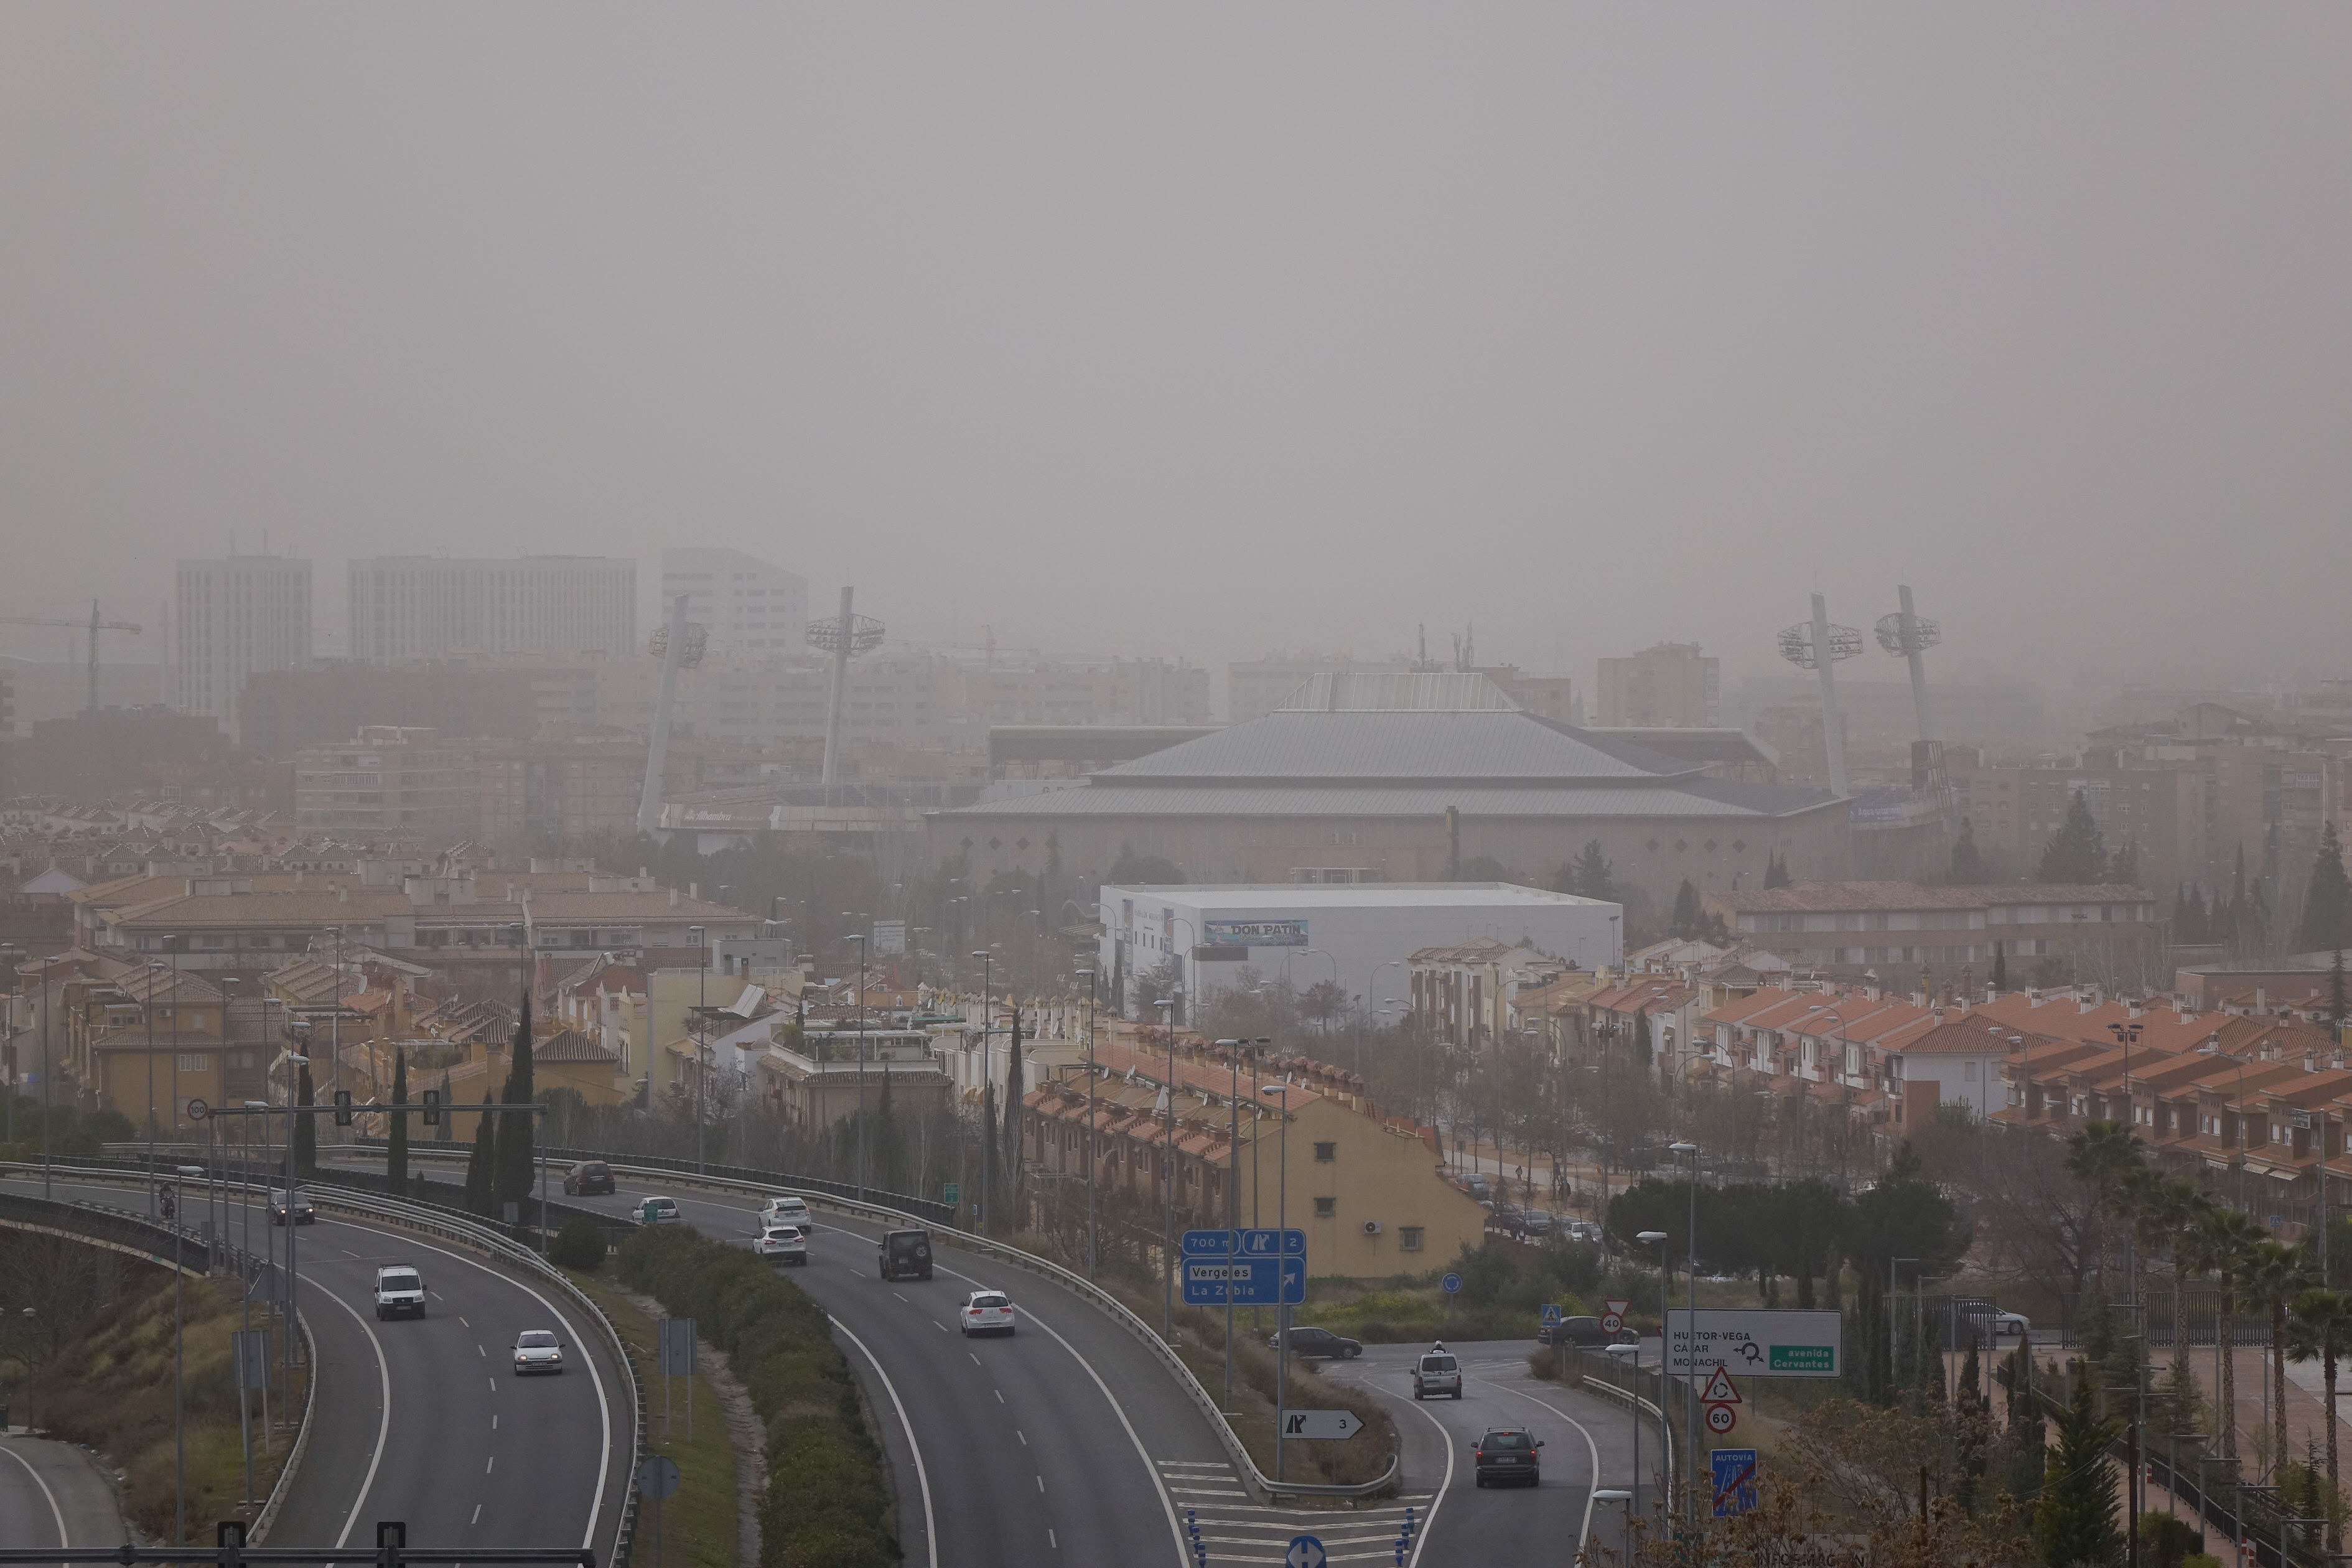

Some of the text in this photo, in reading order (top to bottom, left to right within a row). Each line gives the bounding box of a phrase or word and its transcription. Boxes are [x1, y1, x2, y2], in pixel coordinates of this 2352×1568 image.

[696, 810, 732, 821] Alhambra
[1230, 925, 1259, 935] DON
[1190, 1238, 1216, 1248] 700
[1289, 1238, 1297, 1247] 2
[1192, 1267, 1249, 1279] Vergees
[1192, 1286, 1208, 1295] La
[1605, 1320, 1619, 1328] 40
[1674, 1342, 1709, 1353] CÁAR
[1788, 1349, 1829, 1357] avenida
[1774, 1359, 1829, 1368] Cervantes
[1712, 1413, 1730, 1424] 60
[1338, 1419, 1347, 1429] 3
